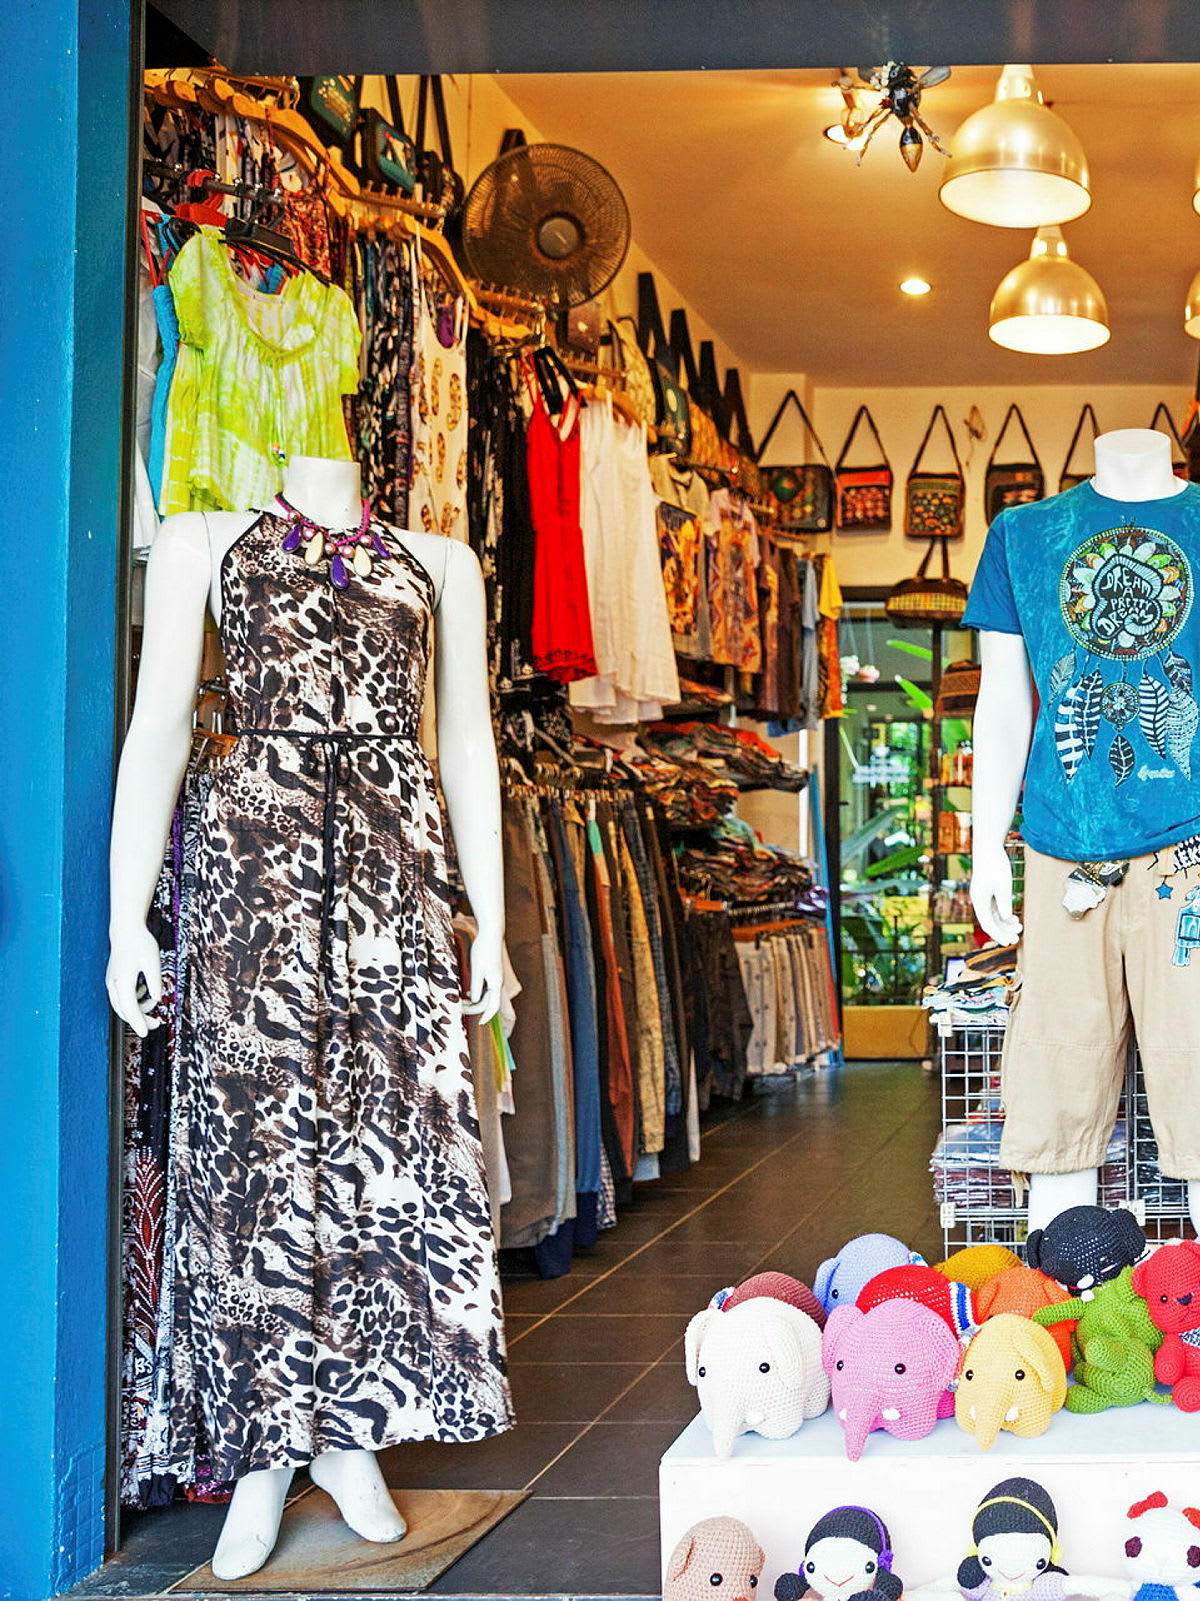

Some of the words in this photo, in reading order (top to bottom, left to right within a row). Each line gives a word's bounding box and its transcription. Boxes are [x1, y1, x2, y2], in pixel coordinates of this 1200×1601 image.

[1101, 566, 1151, 597] DREAM
[1123, 588, 1134, 598] A
[1111, 598, 1152, 611] PRETTY
[1097, 607, 1154, 636] DREAM
